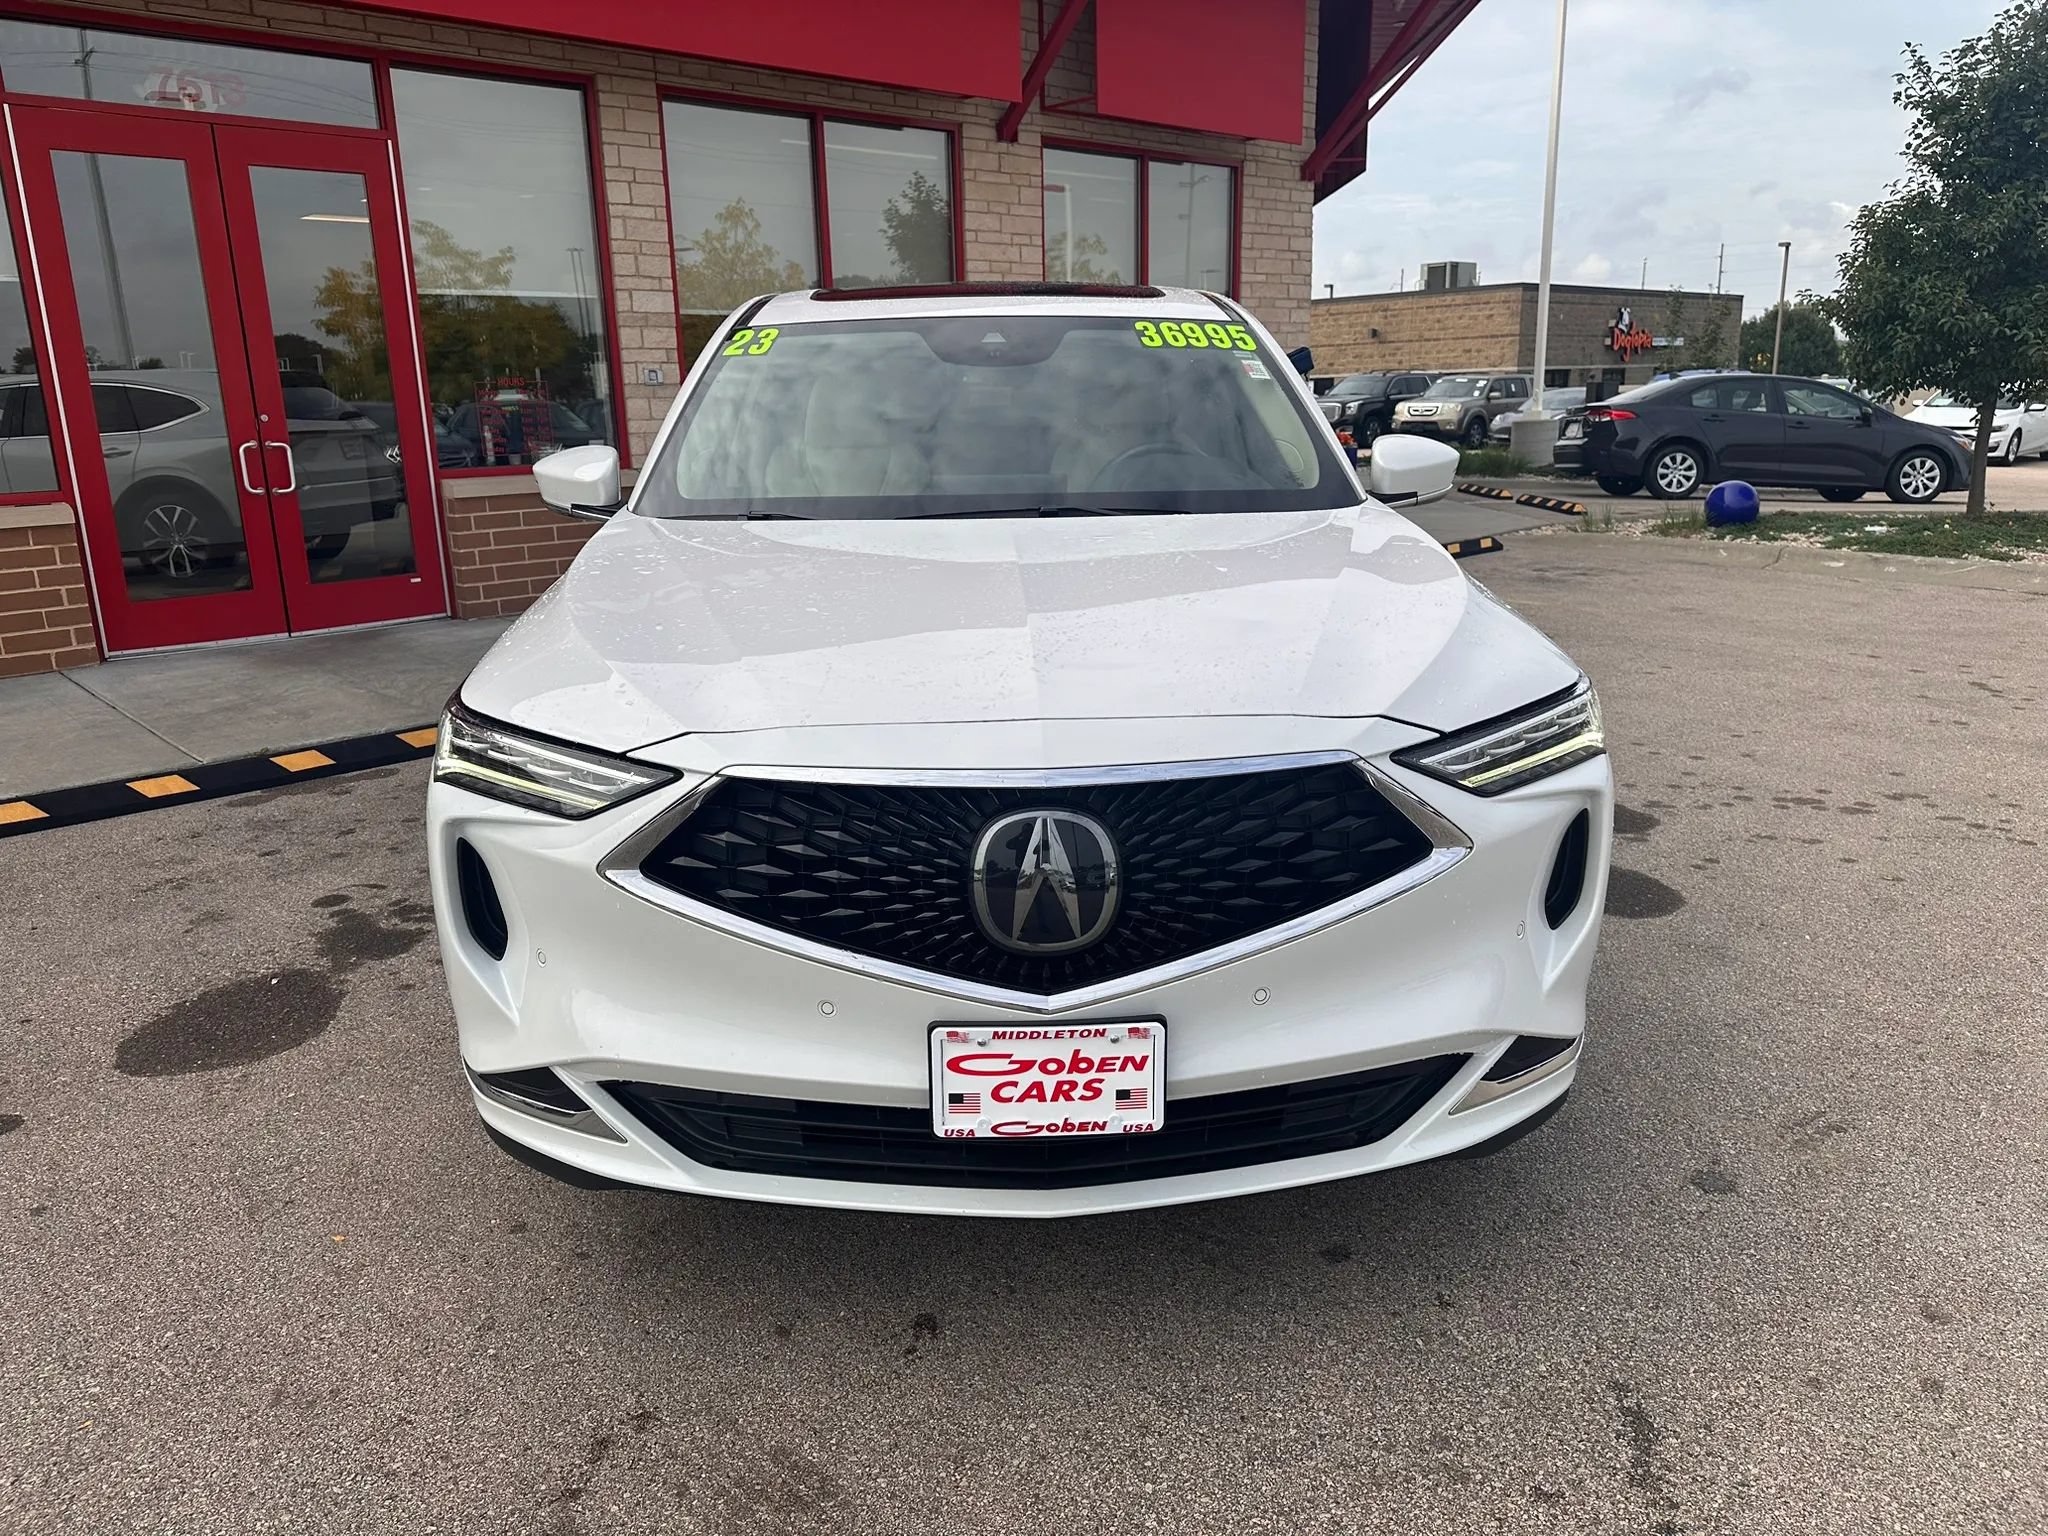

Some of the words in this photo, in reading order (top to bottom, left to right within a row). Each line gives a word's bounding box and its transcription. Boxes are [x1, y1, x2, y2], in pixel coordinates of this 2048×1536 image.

[722, 328, 780, 356] 23
[1134, 320, 1257, 351] 36995
[496, 377, 526, 387] HOURS
[991, 1028, 1108, 1041] MIDDLETON
[990, 1078, 1106, 1103] CARS
[944, 1128, 976, 1138] USA
[1122, 1123, 1155, 1134] USA
